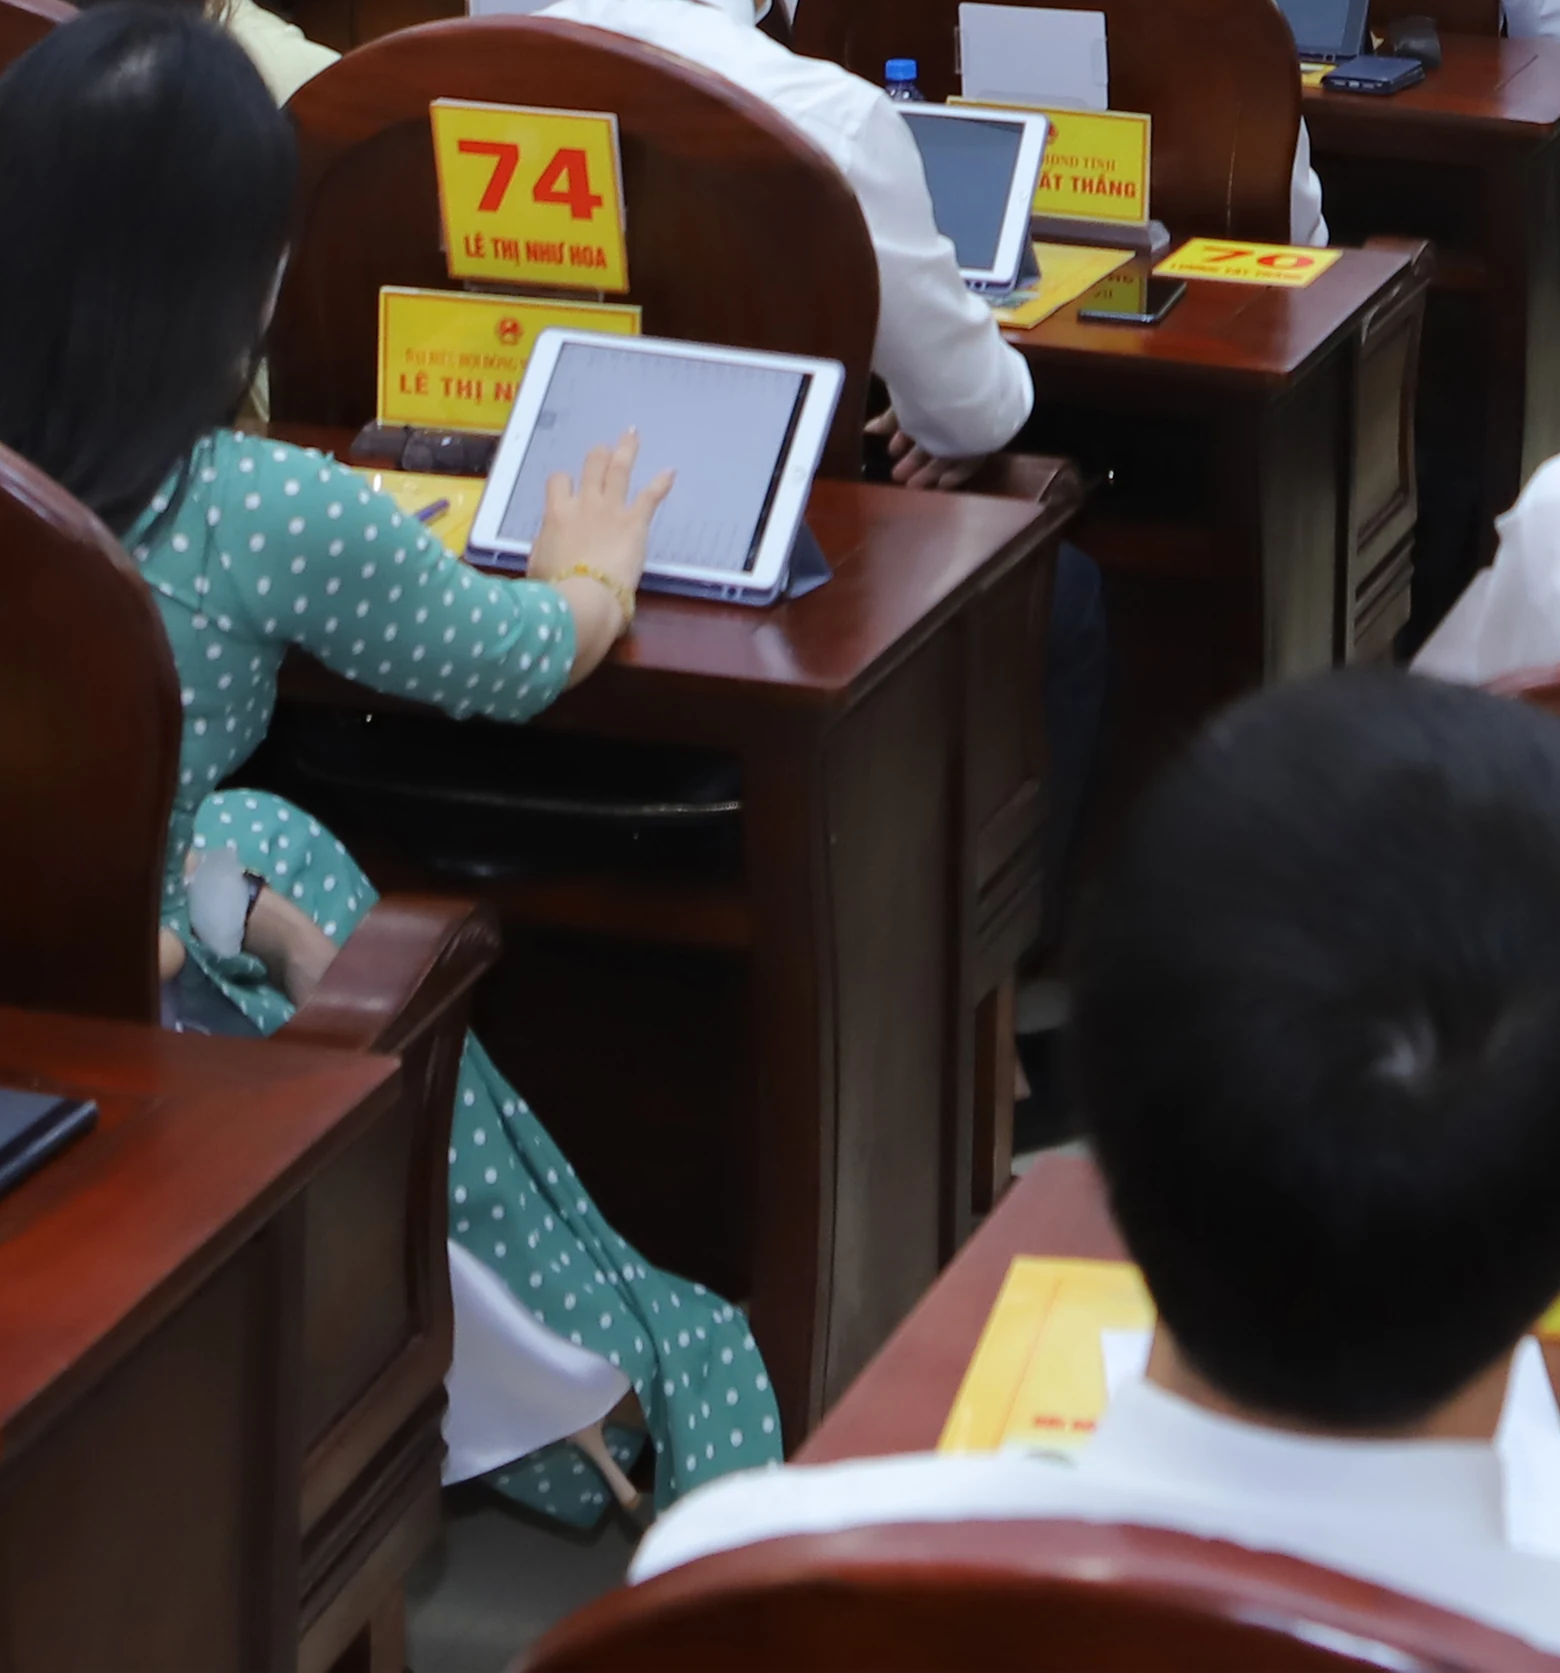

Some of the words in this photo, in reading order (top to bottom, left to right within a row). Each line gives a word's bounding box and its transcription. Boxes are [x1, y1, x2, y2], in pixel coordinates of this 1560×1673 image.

[457, 138, 605, 221] 74
[464, 233, 486, 259] LÊ
[491, 236, 521, 268] THỊ
[526, 239, 565, 266] NHƯ
[569, 242, 608, 270] HOA
[1203, 245, 1316, 270] 70
[399, 370, 429, 396] LÊ
[441, 376, 483, 406] THỊ
